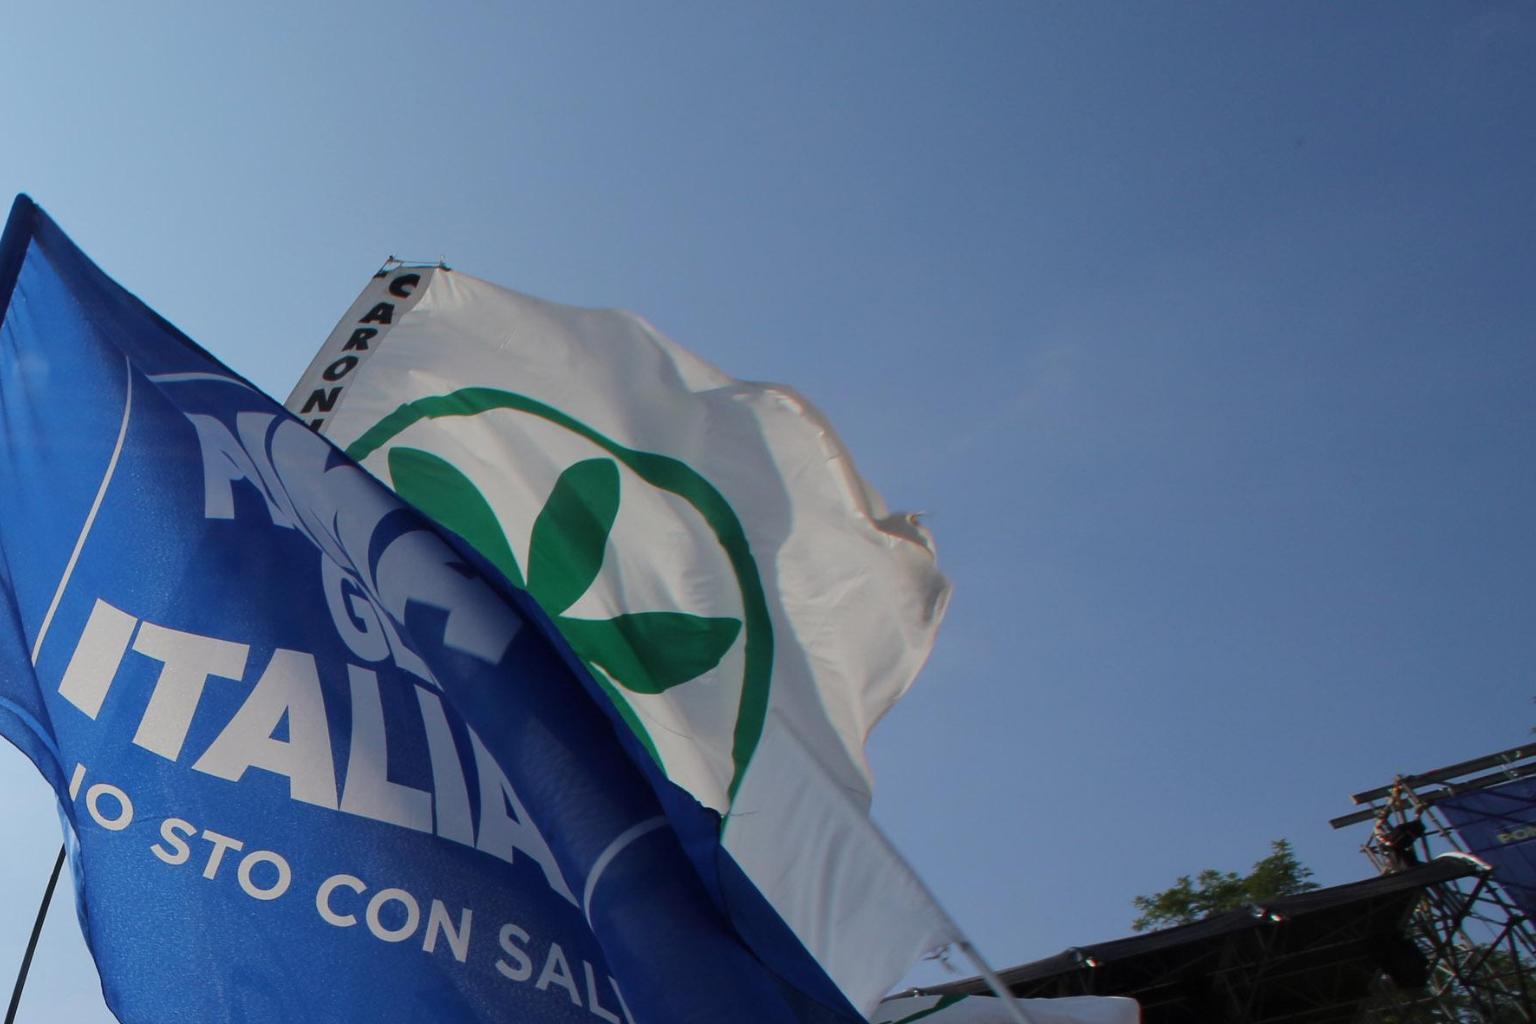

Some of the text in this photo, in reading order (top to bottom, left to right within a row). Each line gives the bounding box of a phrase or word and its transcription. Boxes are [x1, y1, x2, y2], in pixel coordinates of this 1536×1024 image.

[68, 762, 134, 831] IO
[150, 817, 292, 900] STO
[315, 873, 472, 963] CON
